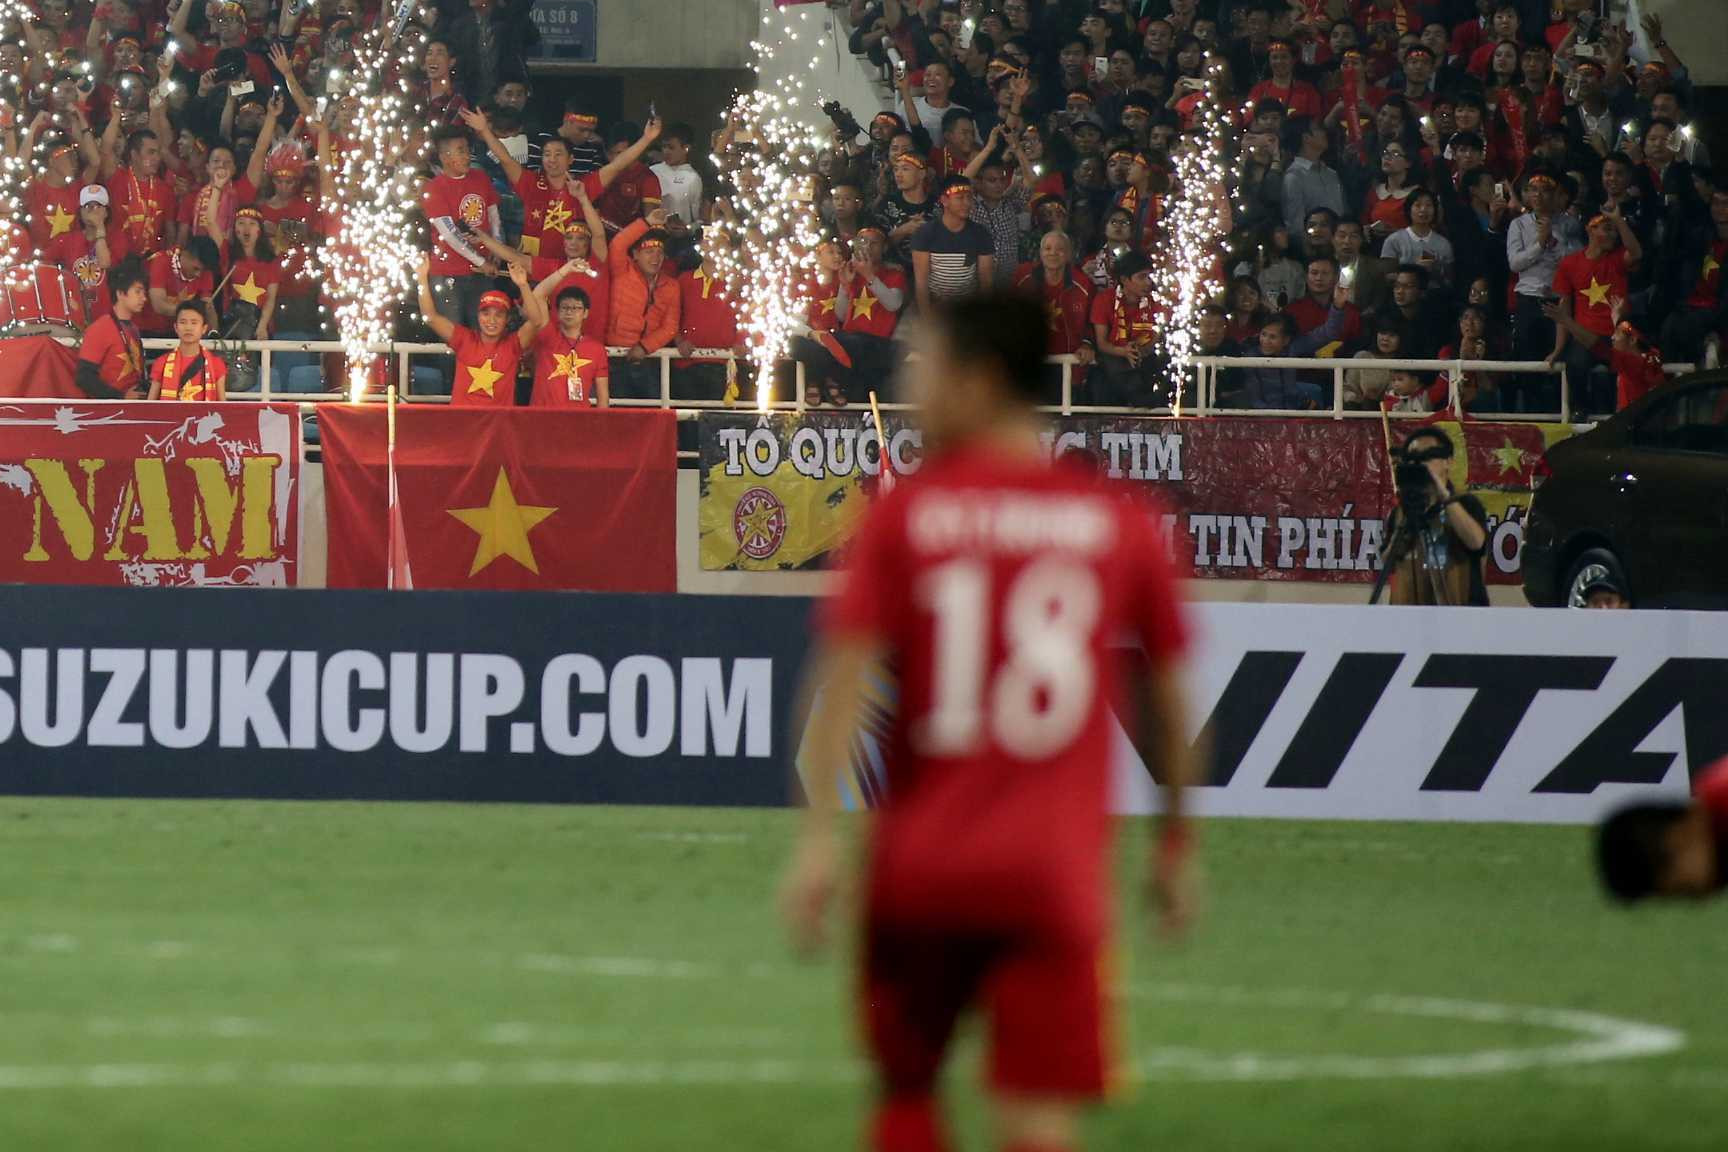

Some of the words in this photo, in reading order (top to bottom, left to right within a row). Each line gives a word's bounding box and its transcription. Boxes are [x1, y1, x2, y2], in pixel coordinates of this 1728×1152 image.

[1101, 431, 1184, 481] TIM
[29, 455, 281, 562] NAM
[1189, 514, 1267, 568] TIN
[1277, 504, 1385, 570] PHÍA
[909, 548, 1104, 760] 18
